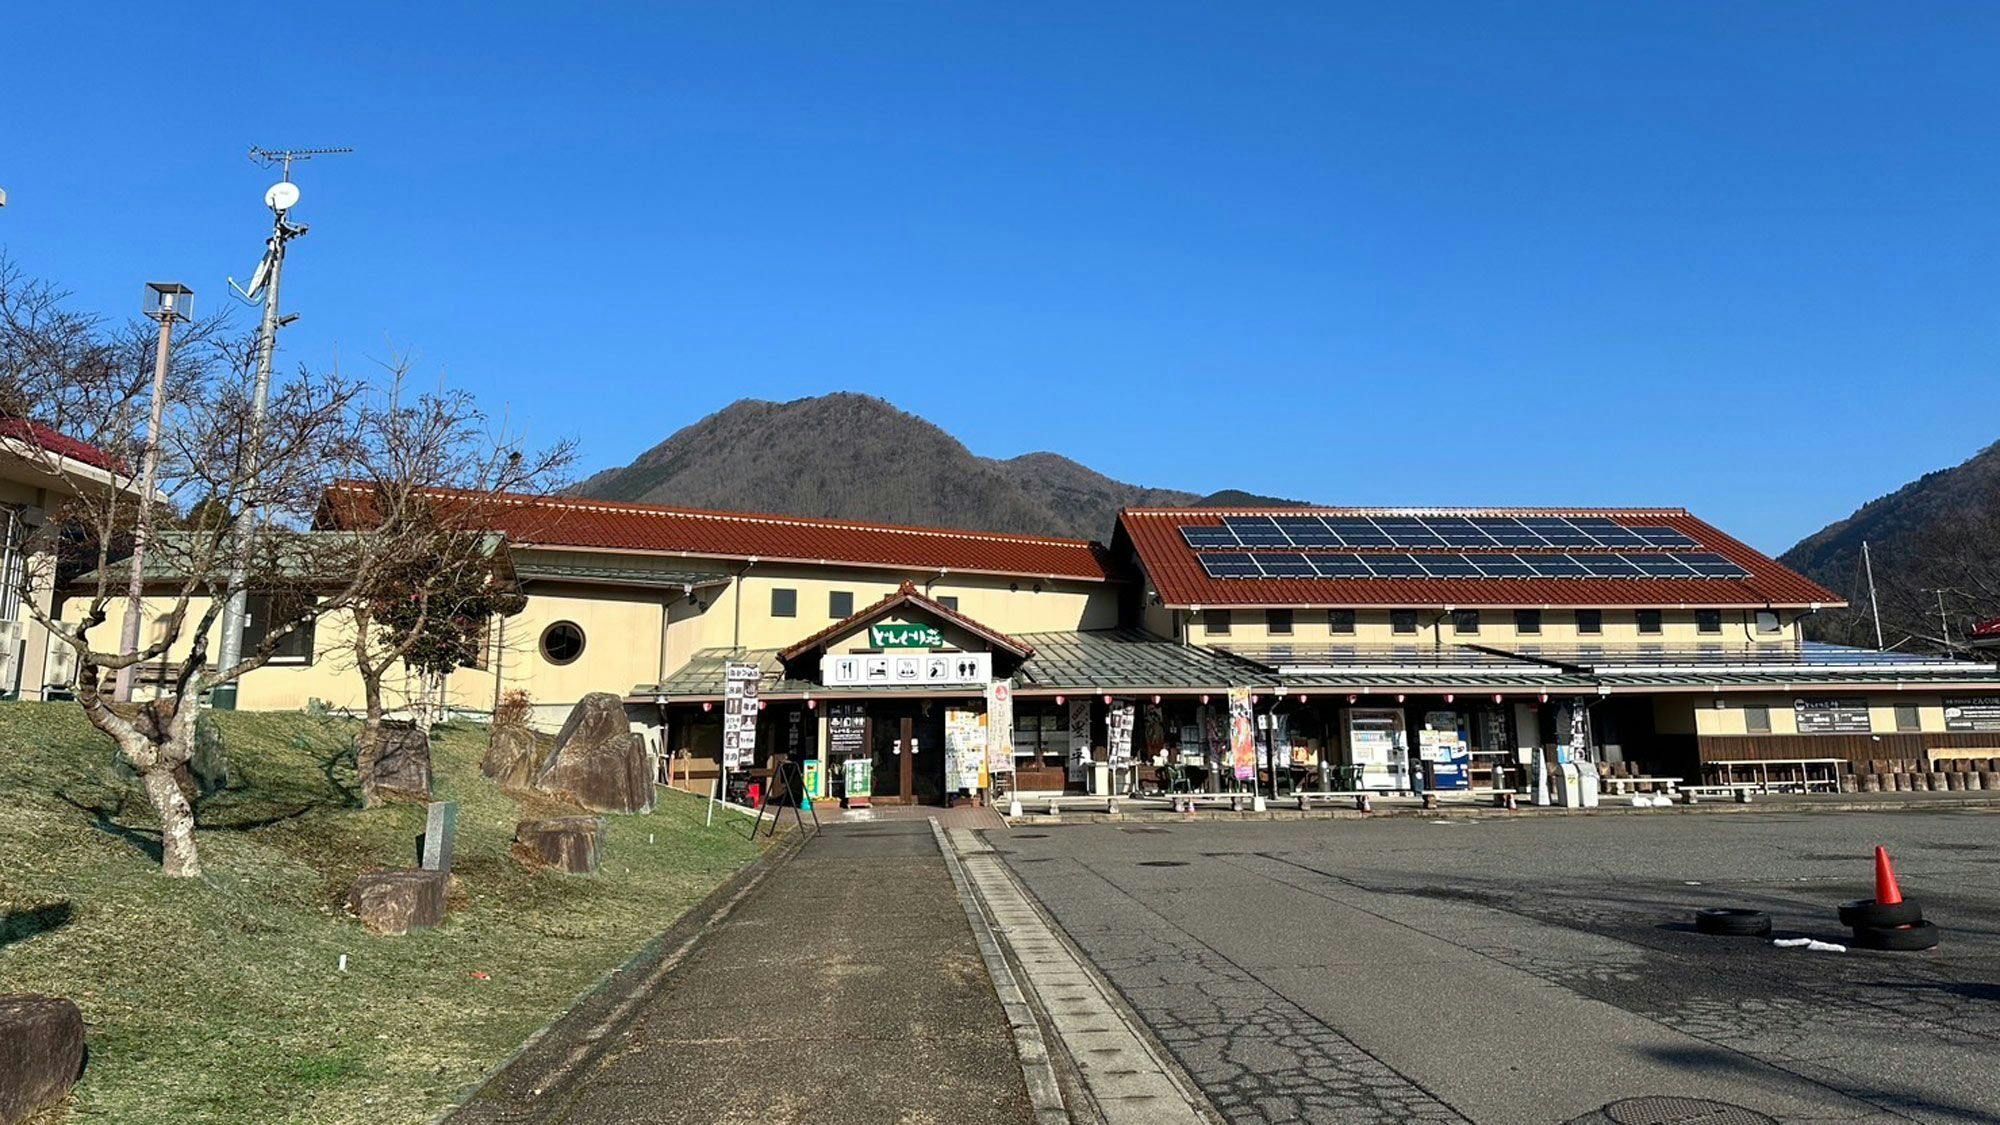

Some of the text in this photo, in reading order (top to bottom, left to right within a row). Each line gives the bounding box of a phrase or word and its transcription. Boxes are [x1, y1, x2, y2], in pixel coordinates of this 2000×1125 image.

[872, 627, 942, 646] どんぐり荘
